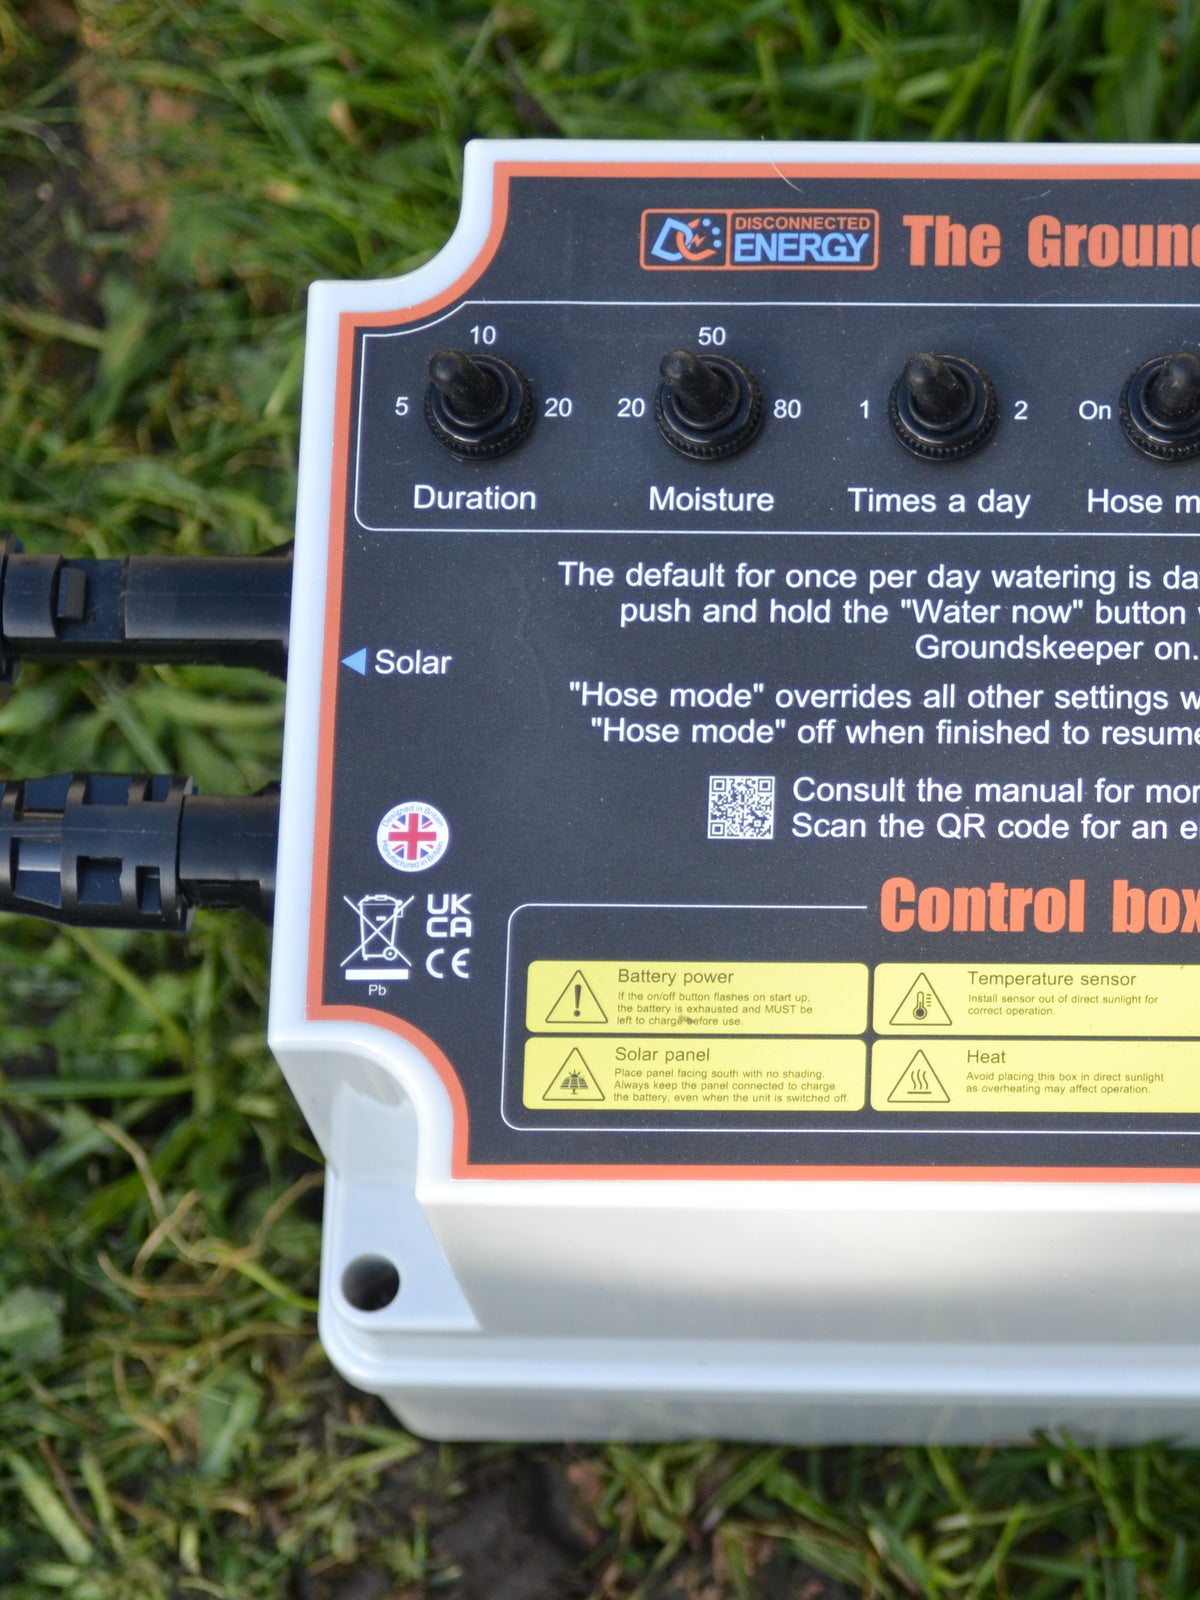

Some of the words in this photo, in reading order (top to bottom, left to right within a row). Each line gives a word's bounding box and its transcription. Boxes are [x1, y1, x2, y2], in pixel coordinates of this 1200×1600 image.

[735, 216, 871, 230] DISCONNECTED
[735, 233, 867, 261] ENERGY
[903, 215, 1001, 267] The
[470, 325, 496, 345] 10
[698, 326, 726, 345] 50
[395, 396, 409, 416] 5
[544, 397, 572, 417] 20
[617, 398, 645, 417] 20
[774, 399, 801, 419] 80
[860, 399, 869, 419] 1
[1014, 400, 1028, 420] 2
[1079, 400, 1111, 420] On
[414, 484, 536, 510] Duration
[649, 486, 774, 512] Moisture
[847, 487, 937, 513] Times
[948, 494, 965, 513] a
[977, 488, 1031, 519] day
[1088, 488, 1163, 513] Hose
[558, 561, 614, 586] The
[626, 561, 725, 587] default
[735, 562, 775, 588] for
[785, 569, 857, 588] once
[869, 569, 917, 594] per
[927, 564, 981, 594] day
[991, 564, 1115, 595] watering
[1129, 564, 1151, 589] is
[620, 598, 690, 628] push
[703, 598, 757, 623] and
[770, 598, 831, 623] hold
[842, 599, 888, 624] the
[901, 599, 1001, 623] "Water
[1012, 599, 1083, 624] now"
[1096, 599, 1186, 625] button
[915, 634, 1144, 665] Groundskeeper
[1154, 641, 1198, 660] on.
[375, 649, 452, 674] Solar
[570, 681, 658, 707] "Hose
[670, 683, 764, 708] mode"
[775, 683, 911, 708] overrides
[923, 683, 955, 708] all
[968, 683, 1044, 709] other
[1055, 684, 1169, 715] settings
[591, 717, 679, 743] "Hose
[692, 718, 786, 744] mode"
[797, 718, 837, 744] off
[845, 719, 924, 744] when
[936, 719, 1050, 744] finished
[1062, 720, 1090, 745] to
[793, 776, 906, 802] Consult
[916, 777, 962, 802] the
[975, 778, 1082, 803] manual
[1094, 777, 1135, 803] for
[792, 812, 866, 838] Scan
[878, 813, 924, 838] the
[937, 813, 986, 839] QR
[998, 813, 1069, 839] code
[1081, 813, 1121, 839] for
[1132, 820, 1167, 839] an
[427, 894, 471, 915] UK
[881, 877, 1085, 932] Control
[426, 917, 472, 937] CA
[618, 968, 677, 987] Battery
[683, 972, 734, 986] power
[967, 971, 1074, 988] Temperature
[1081, 975, 1137, 986] sensor
[369, 984, 387, 996] Pb
[969, 994, 998, 1003] Install
[1038, 995, 1054, 1003] out
[1058, 994, 1068, 1003] of
[1071, 995, 1099, 1003] direct
[1102, 995, 1141, 1006] sunlight
[1145, 995, 1158, 1004] for
[617, 1004, 633, 1013] the
[637, 1004, 671, 1015] battery
[675, 1004, 683, 1013] is
[686, 1004, 738, 1013] exhausted
[742, 1005, 761, 1013] and
[765, 1005, 796, 1014] MUST
[800, 1005, 813, 1014] be
[615, 1046, 659, 1061] Solar
[665, 1048, 710, 1064] panel
[967, 1049, 1006, 1064] Heat
[614, 1080, 649, 1091] Always
[653, 1080, 678, 1091] keep
[681, 1081, 697, 1090] the
[701, 1081, 728, 1091] panel
[732, 1082, 784, 1090] connected
[788, 1082, 797, 1090] to
[801, 1082, 835, 1092] charge
[966, 1072, 994, 1081] Avoid
[998, 1072, 1034, 1083] placing
[1038, 1072, 1055, 1081] this
[1059, 1073, 1077, 1081] box
[1081, 1073, 1090, 1081] in
[1093, 1073, 1121, 1081] direct
[1125, 1073, 1164, 1084] sunlight
